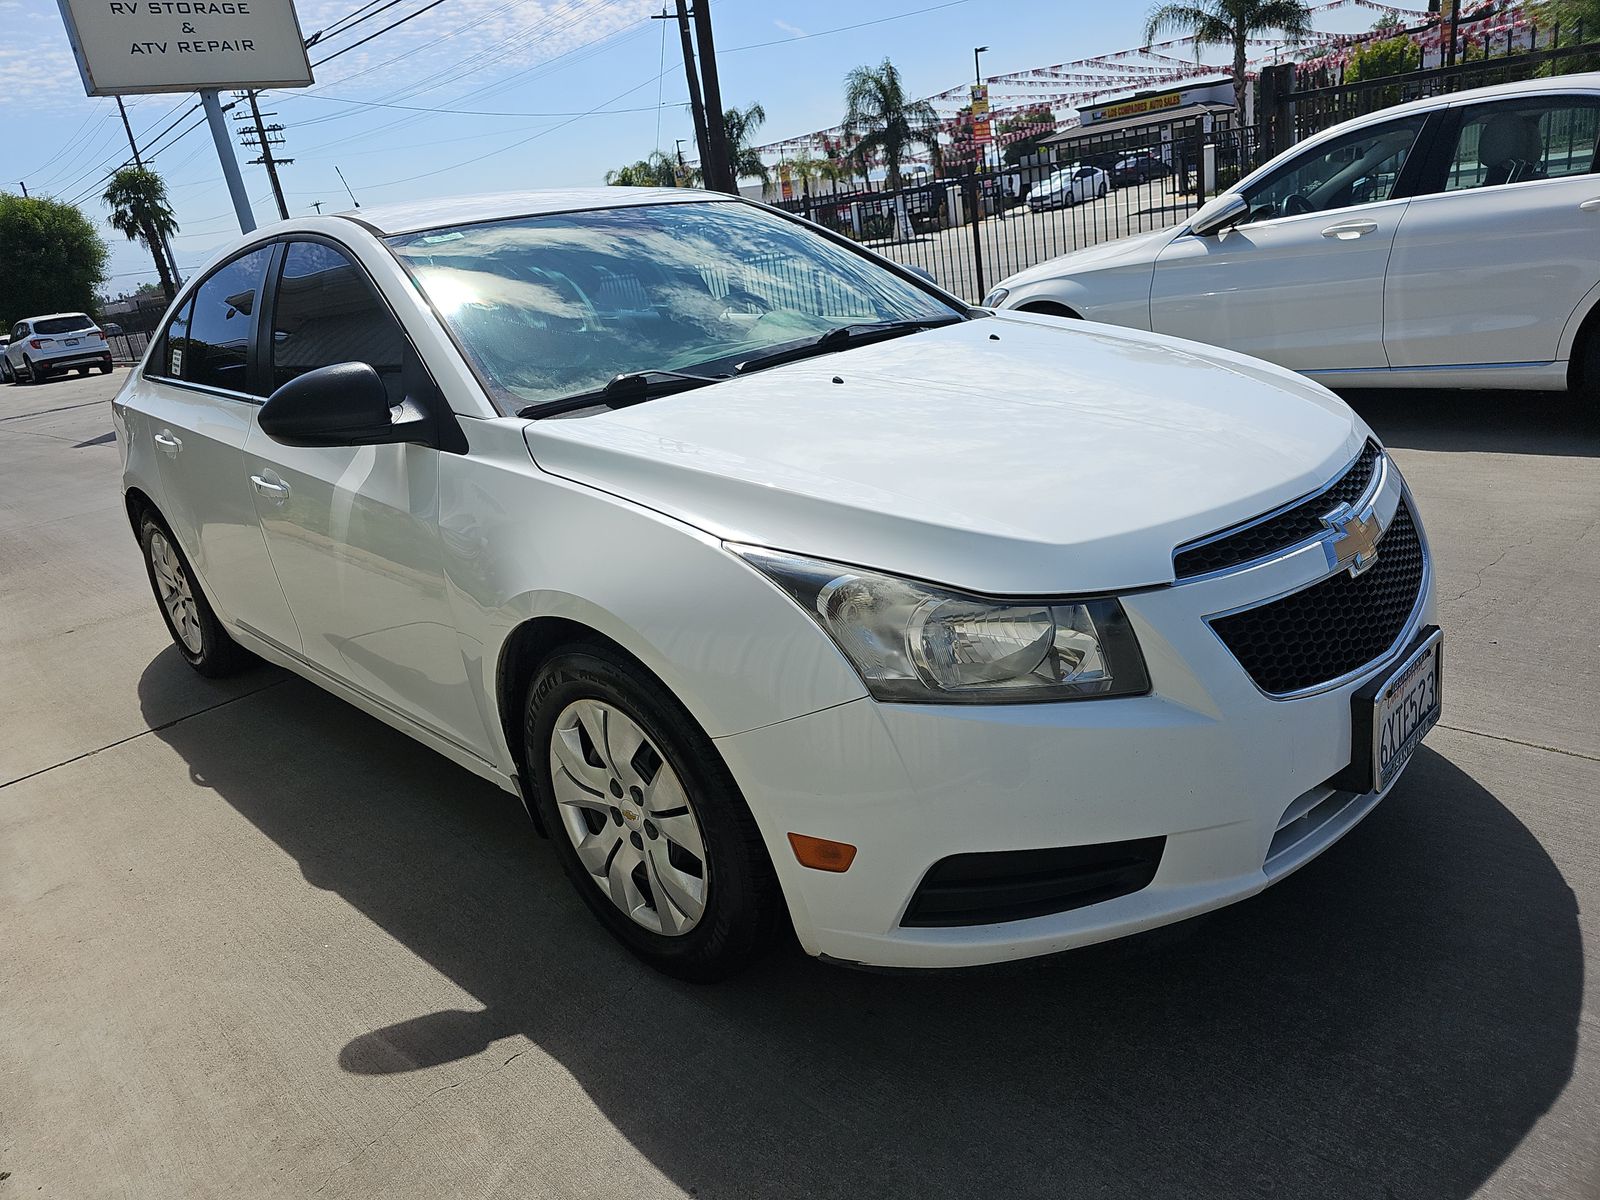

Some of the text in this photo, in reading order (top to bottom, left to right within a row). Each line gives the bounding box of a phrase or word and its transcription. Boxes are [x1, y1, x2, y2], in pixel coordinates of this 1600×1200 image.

[110, 2, 250, 15] RV STORAGE
[181, 22, 196, 34] &
[130, 39, 256, 55] ATV REPAIR
[1163, 95, 1180, 107] SALES
[1380, 671, 1435, 770] 6XTF523
